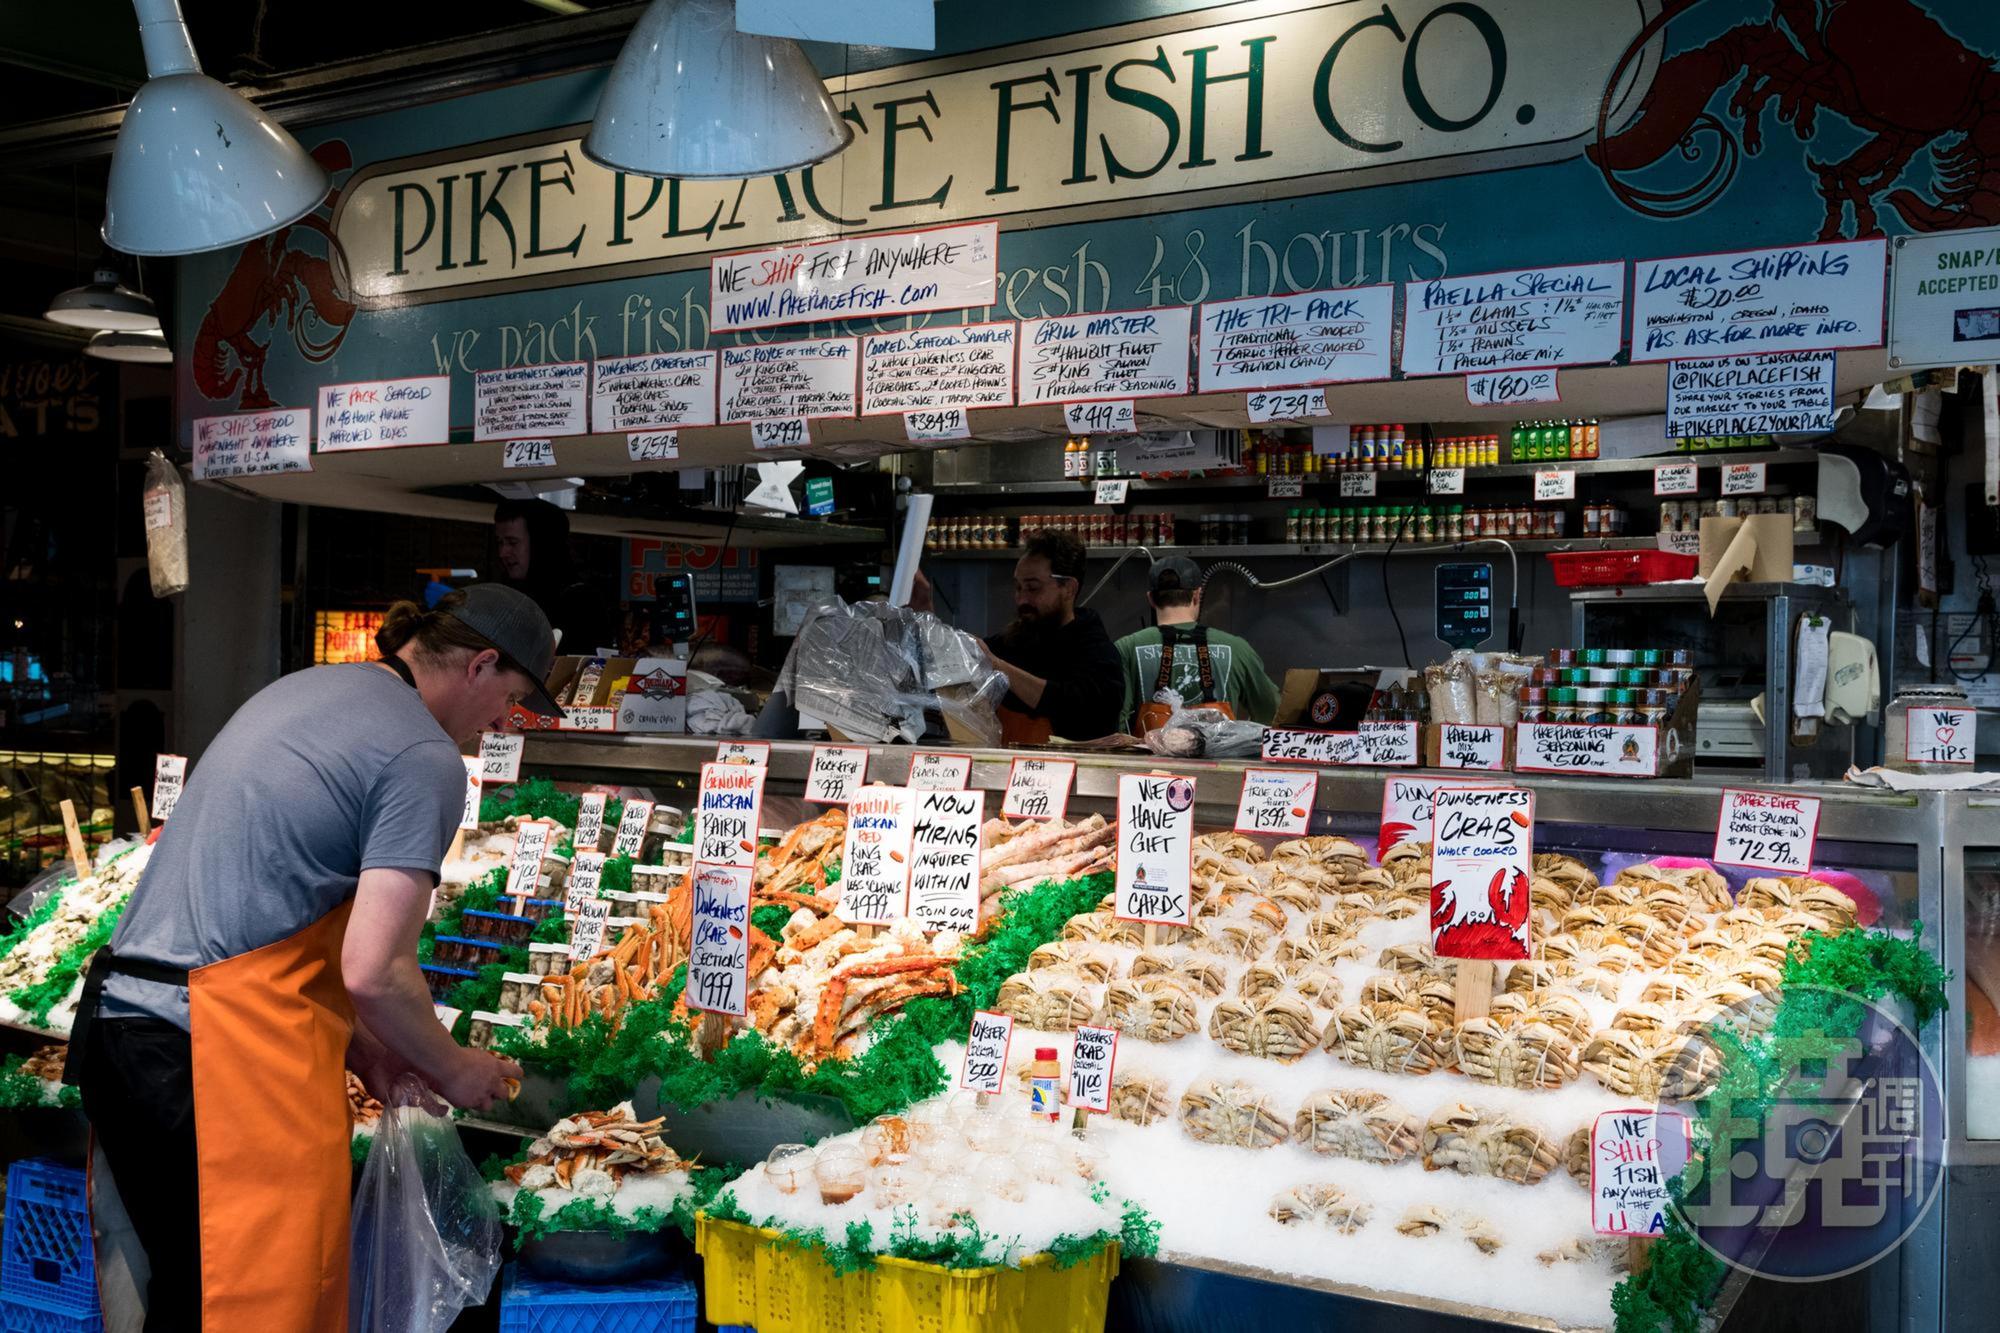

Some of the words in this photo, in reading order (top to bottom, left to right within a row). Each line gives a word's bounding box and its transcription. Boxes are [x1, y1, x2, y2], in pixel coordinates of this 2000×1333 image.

[386, 149, 587, 276] PIKE
[985, 35, 1277, 196] FISH
[1312, 1, 1537, 153] CO.
[719, 259, 752, 294] WE
[865, 242, 968, 278] ANYWHERE
[1643, 263, 1722, 294] LOCAL
[1917, 274, 1999, 297] ACCEPTED
[430, 324, 479, 376] we
[498, 303, 602, 367] pack
[620, 286, 710, 356] fish
[1134, 229, 1212, 308] 48
[1234, 219, 1448, 299] hours
[1422, 281, 1505, 310] PAELLA
[1206, 309, 1255, 332] THE
[1470, 301, 1530, 324] CLAMS
[960, 327, 1013, 345] SAMPLER
[1033, 320, 1080, 345] GRILL
[1085, 314, 1160, 339] MASTER
[1306, 322, 1364, 337] SMOKED
[1475, 316, 1551, 336] MUSSELS
[1684, 327, 1720, 346] ASK
[1760, 321, 1811, 340] MORE
[819, 341, 852, 358] SEA
[1117, 341, 1162, 357] FILLET
[1311, 339, 1365, 354] SMOKED
[1471, 334, 1526, 353] PRAWNS
[969, 349, 994, 362] CRAB
[1718, 358, 1731, 368] US
[1735, 357, 1751, 367] ON
[1756, 351, 1834, 366] INSTAGRAM
[1057, 363, 1090, 381] KING
[1229, 358, 1287, 375] SALMON
[674, 374, 701, 387] CRAB
[1119, 379, 1177, 392] SEASONING
[1672, 366, 1821, 391] @PIKEPLACEFISH
[328, 391, 346, 409] WE
[349, 388, 380, 406] PACK
[384, 385, 431, 402] SEAFOOD
[1707, 391, 1731, 402] YOUR
[1736, 390, 1784, 401] STORIES
[1789, 387, 1826, 397] FROM
[1673, 405, 1691, 415] OUR
[1695, 403, 1738, 414] MARKET
[1760, 400, 1787, 410] YOUR
[1791, 397, 1830, 408] TABLE
[199, 423, 215, 440] WE
[1934, 710, 1964, 728] WE
[1262, 729, 1302, 745] BEST
[1304, 732, 1334, 746] HAT
[1446, 725, 1494, 746] PAELLA
[703, 766, 757, 790] GENUINE
[1138, 778, 1169, 801] WE
[1274, 787, 1294, 798] COD
[1436, 792, 1529, 806] DUNGENESS
[703, 790, 754, 811] ALASKAN
[924, 792, 976, 816] NOW
[853, 816, 898, 830] ALASKAN
[1128, 804, 1177, 830] HAVE
[1731, 809, 1757, 821] KING
[1759, 811, 1799, 825] SALMON
[913, 816, 978, 849] HIRING
[1440, 810, 1516, 845] CRAB
[700, 838, 737, 860] CRAB
[851, 841, 882, 861] KING
[1130, 831, 1177, 854] GIFT
[1437, 845, 1471, 857] WHOLE
[1473, 845, 1518, 857] COOKED
[914, 851, 975, 869] INQUIRE
[914, 872, 971, 891] WITHIN
[915, 905, 946, 918] JOIN
[949, 906, 975, 920] OUR
[1127, 892, 1186, 919] CARDS
[695, 918, 728, 946] CRAB
[972, 1020, 1008, 1042] OYSTER
[1074, 1045, 1106, 1060] CRAB
[1613, 1115, 1652, 1141] WE
[1612, 1164, 1664, 1186] FISH
[1627, 1199, 1654, 1211] THE
